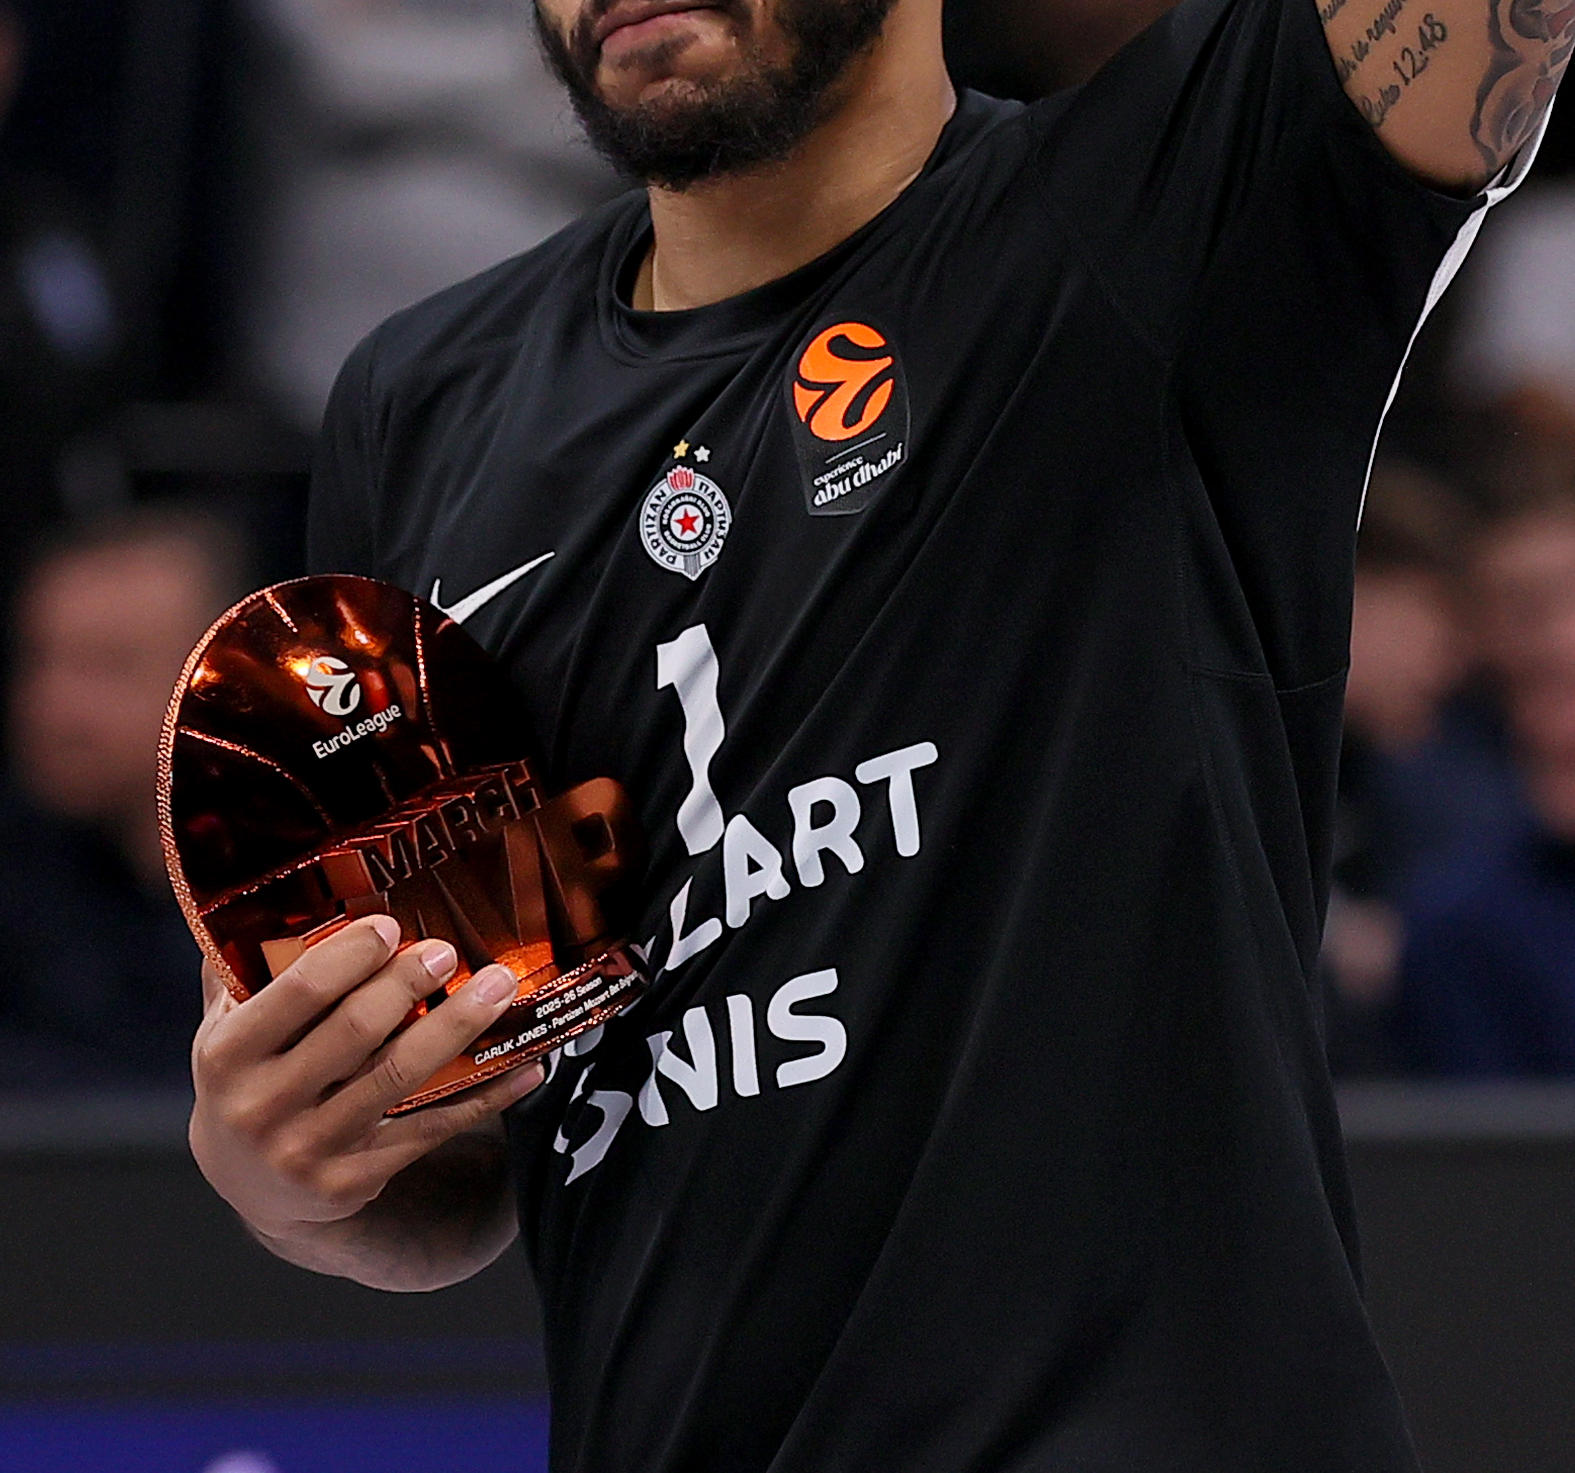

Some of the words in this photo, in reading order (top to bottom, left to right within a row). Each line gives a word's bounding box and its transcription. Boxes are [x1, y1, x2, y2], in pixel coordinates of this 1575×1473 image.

[1392, 12, 1448, 86] 12:48
[813, 456, 864, 486] experience
[813, 477, 852, 506] abu
[852, 442, 904, 487] dhabi
[645, 489, 678, 565] PARTIZAN
[312, 704, 402, 759] EuroLeague
[657, 624, 725, 855] 1
[359, 759, 543, 894] MARCH
[535, 989, 576, 1019] 2025-26
[474, 1039, 515, 1065] CARLIK
[515, 1023, 548, 1047] JONES
